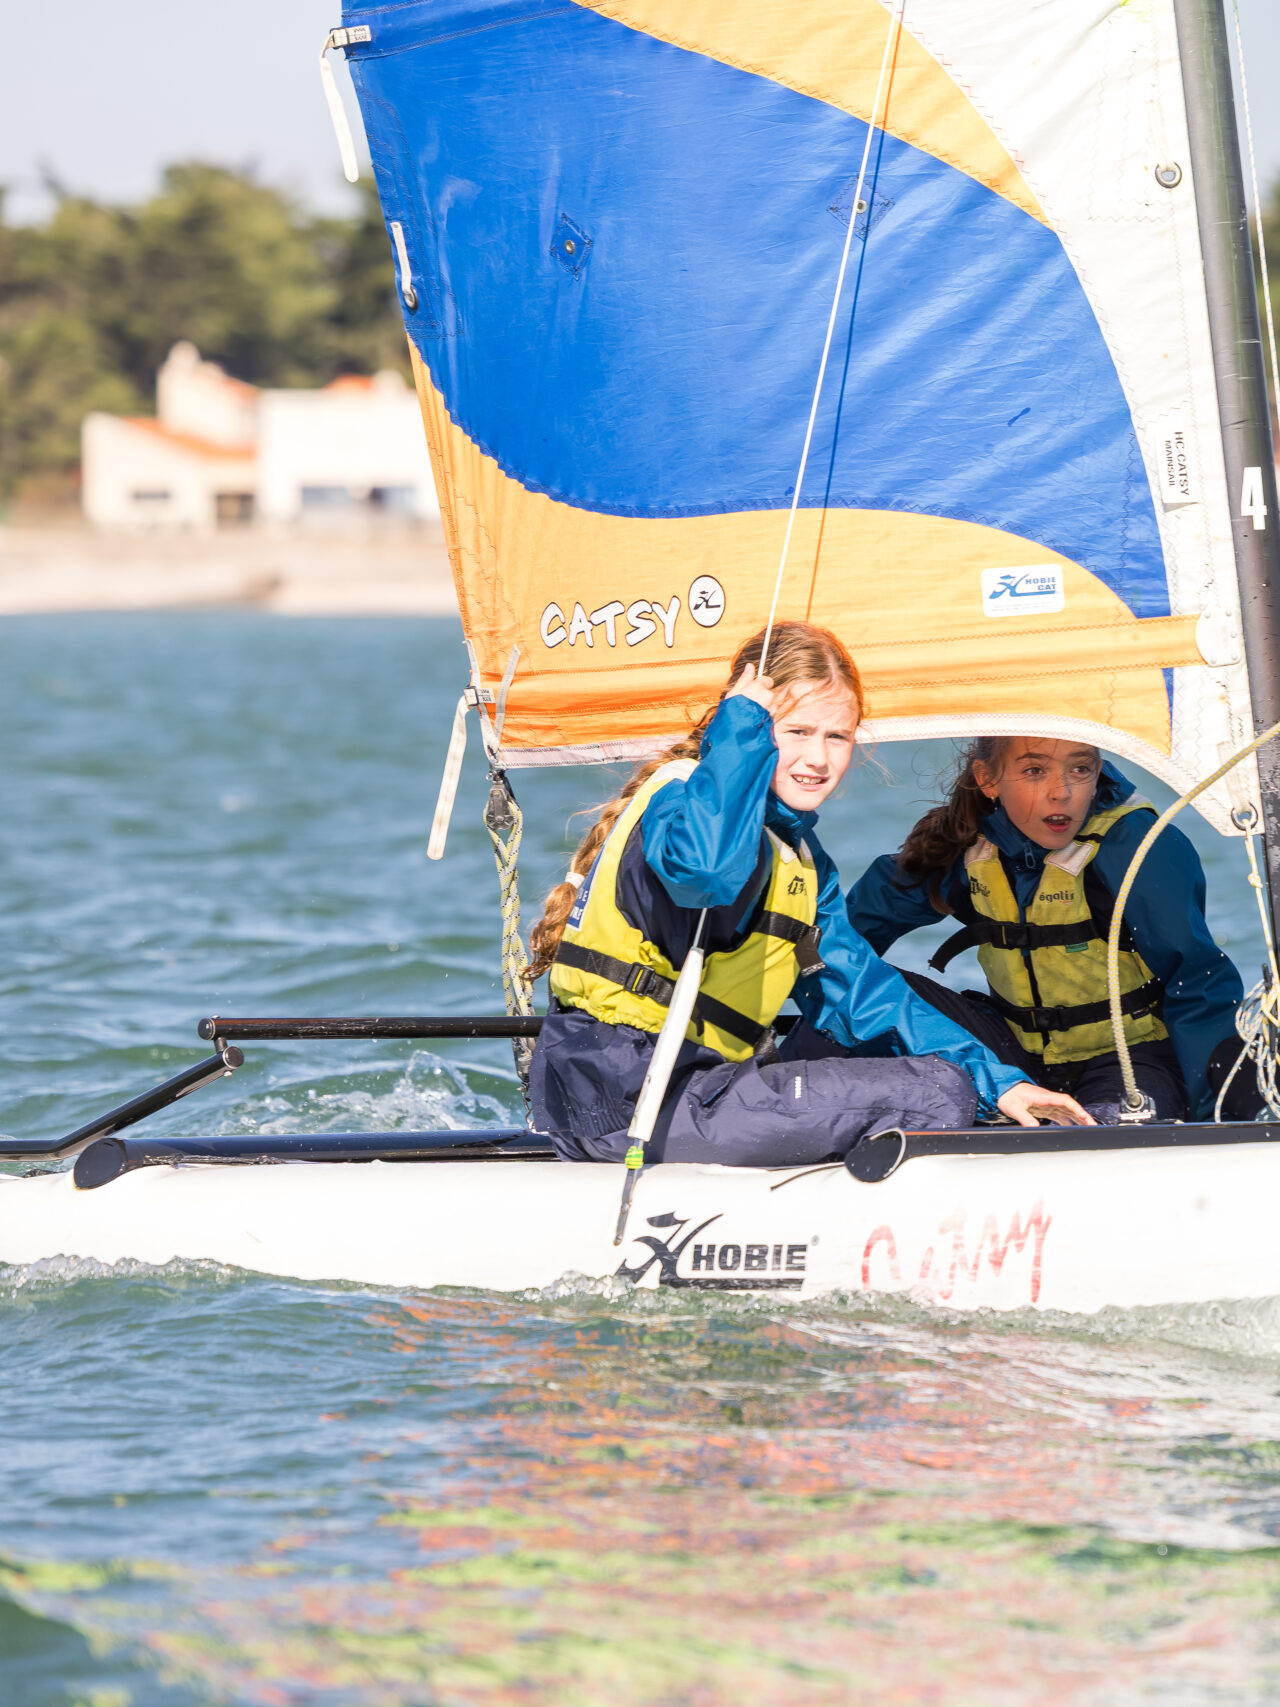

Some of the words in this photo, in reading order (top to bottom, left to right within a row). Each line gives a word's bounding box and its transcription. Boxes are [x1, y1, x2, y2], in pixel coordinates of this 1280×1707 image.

[1241, 466, 1268, 530] 4
[1025, 576, 1057, 585] HOBIE
[540, 594, 682, 648] CATSY
[691, 1243, 809, 1272] HOBIE
